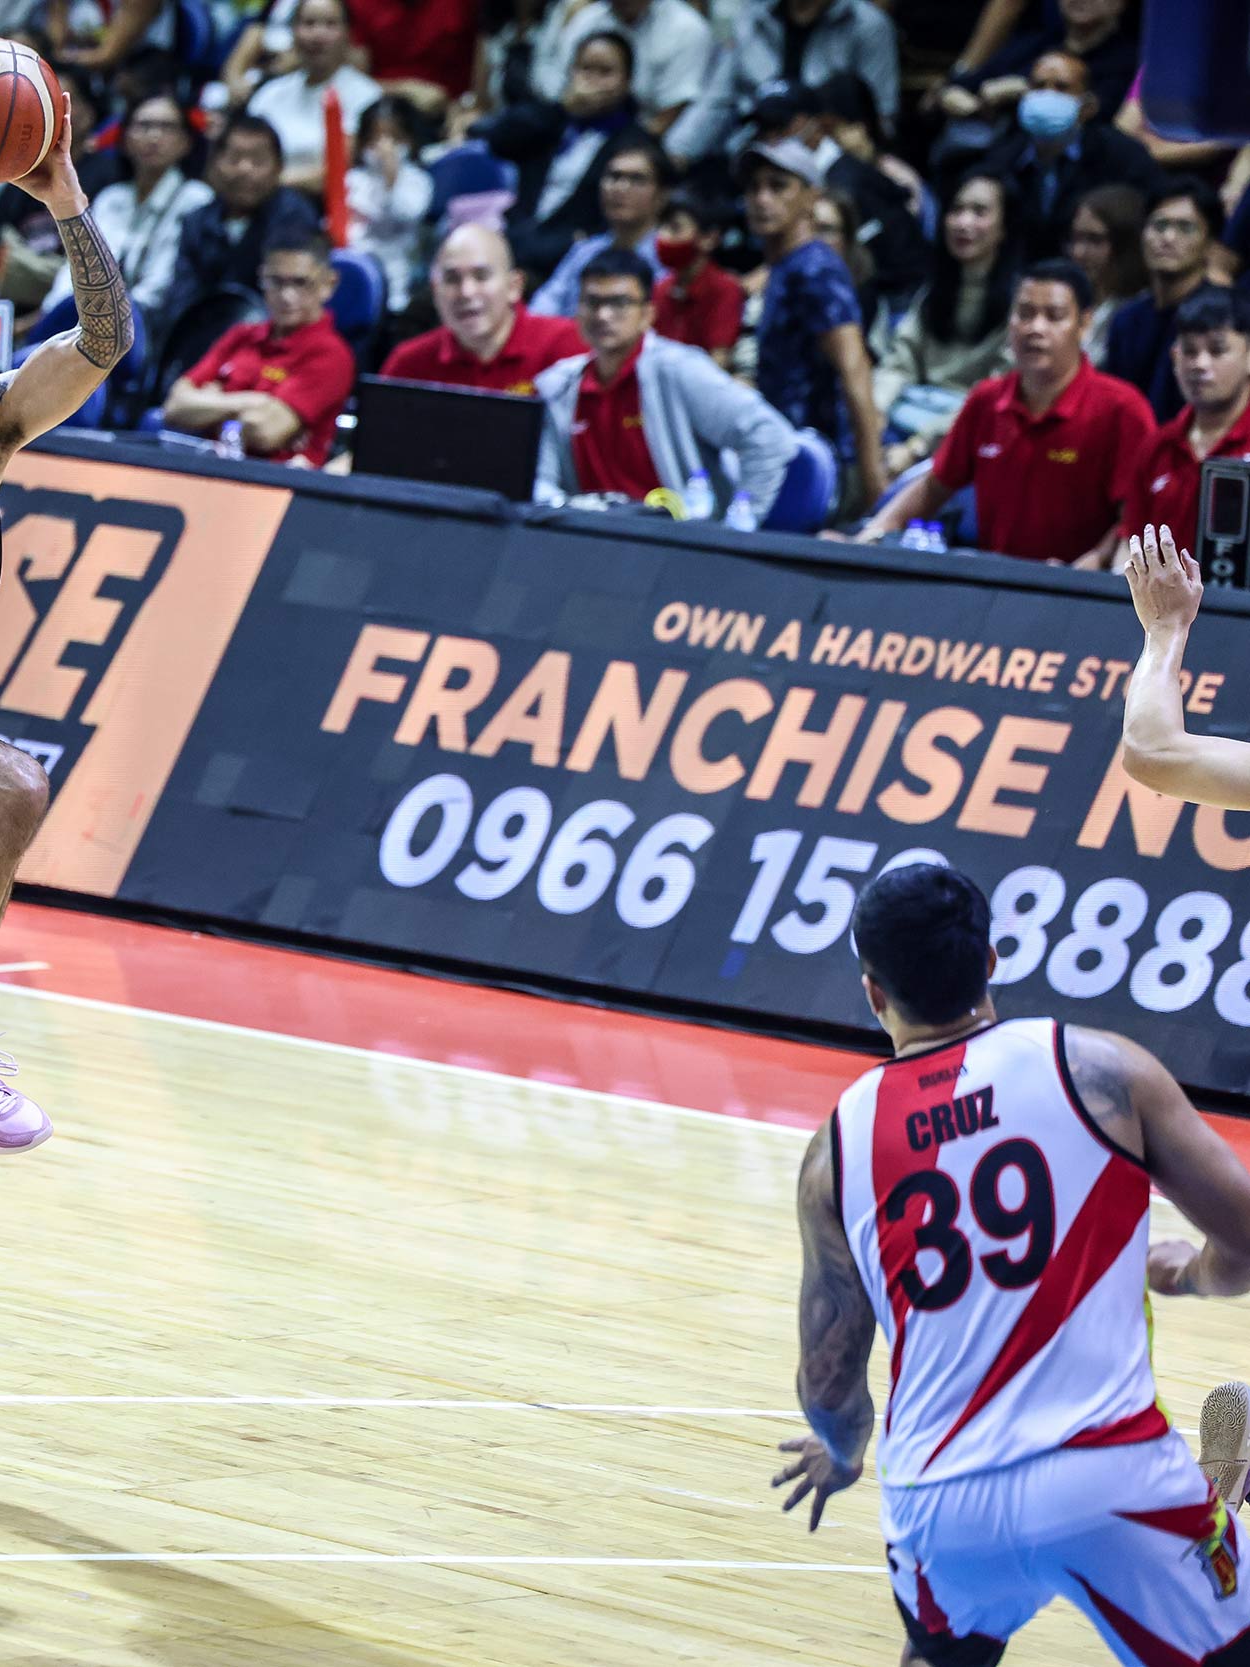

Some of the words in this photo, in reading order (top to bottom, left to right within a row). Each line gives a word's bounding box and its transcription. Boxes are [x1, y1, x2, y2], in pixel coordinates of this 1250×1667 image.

[320, 623, 1072, 839] FRANCHISE
[653, 601, 765, 654] OWN
[766, 618, 802, 661] A
[810, 623, 1067, 693] HARDWARE
[1068, 656, 1225, 714] STE
[379, 773, 715, 928] 0966
[730, 828, 950, 959] 15
[905, 1084, 999, 1152] CRUZ
[884, 1137, 1056, 1313] 39
